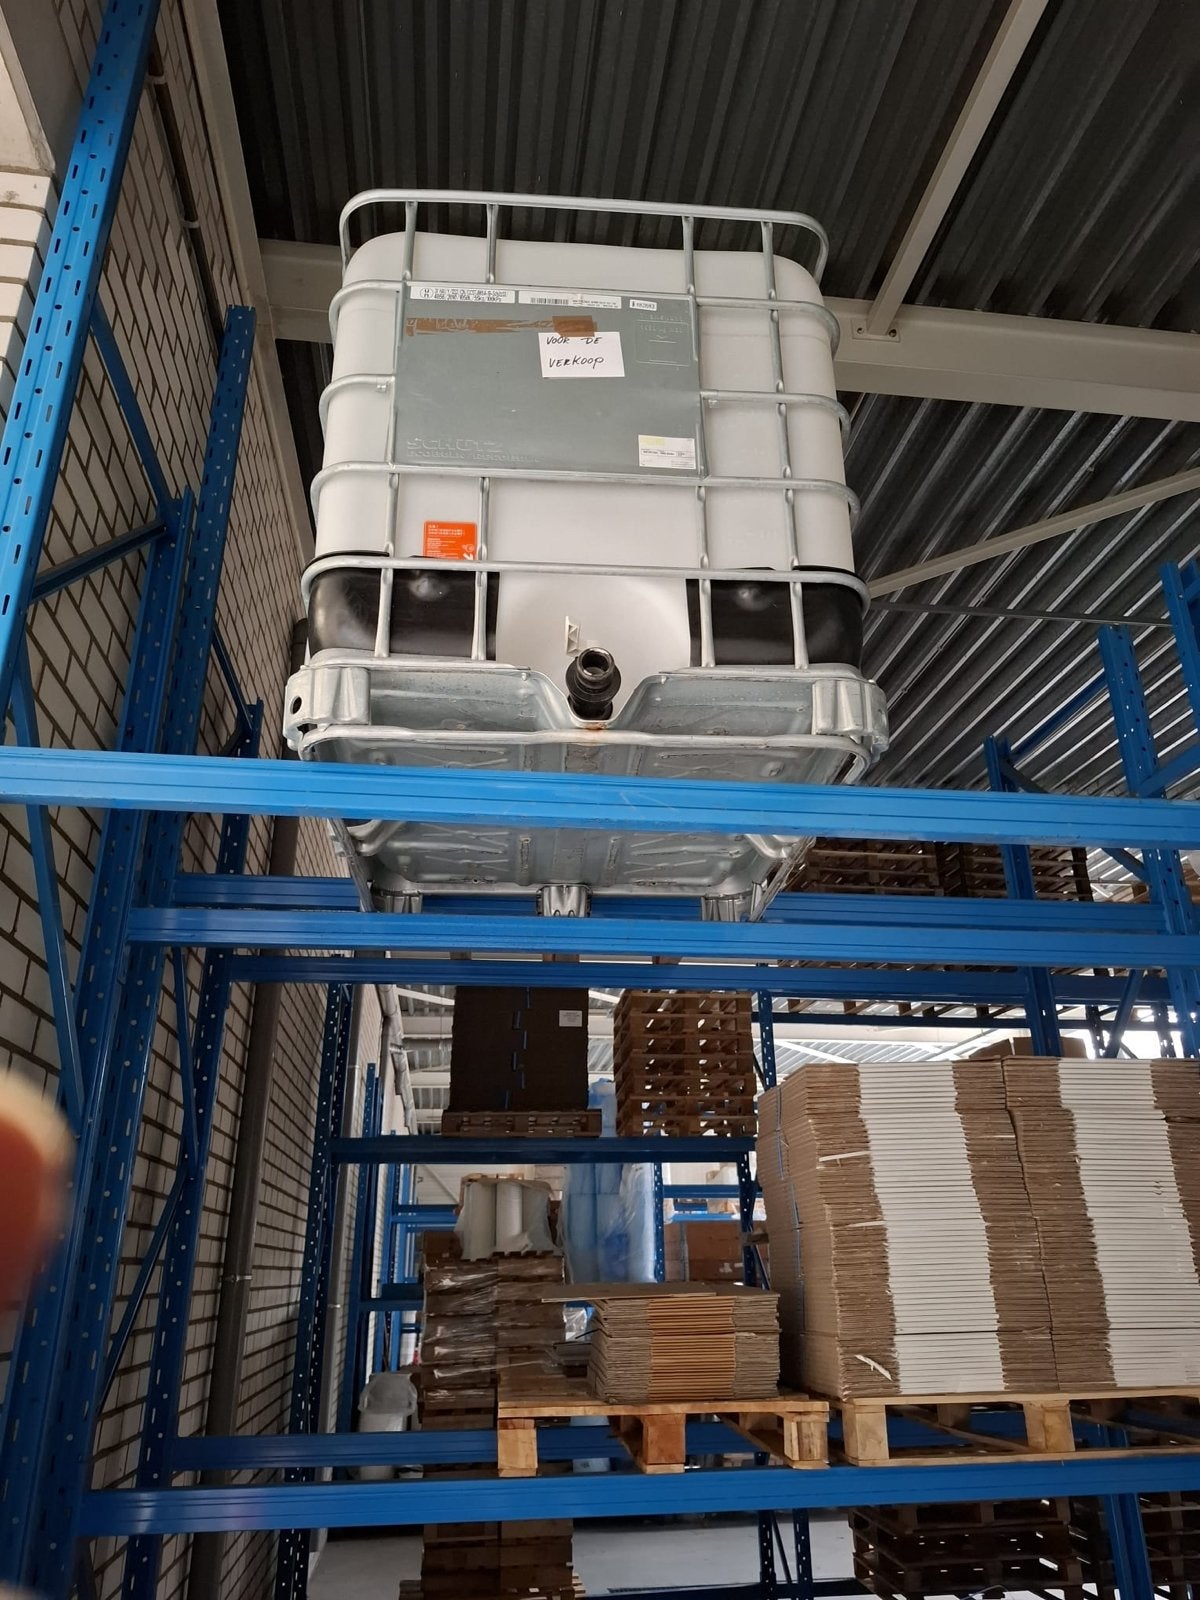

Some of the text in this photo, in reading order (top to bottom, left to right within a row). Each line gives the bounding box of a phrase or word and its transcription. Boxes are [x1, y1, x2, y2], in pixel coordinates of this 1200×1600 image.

[546, 336, 603, 345] VOOR DE
[549, 355, 605, 369] VERKOOP
